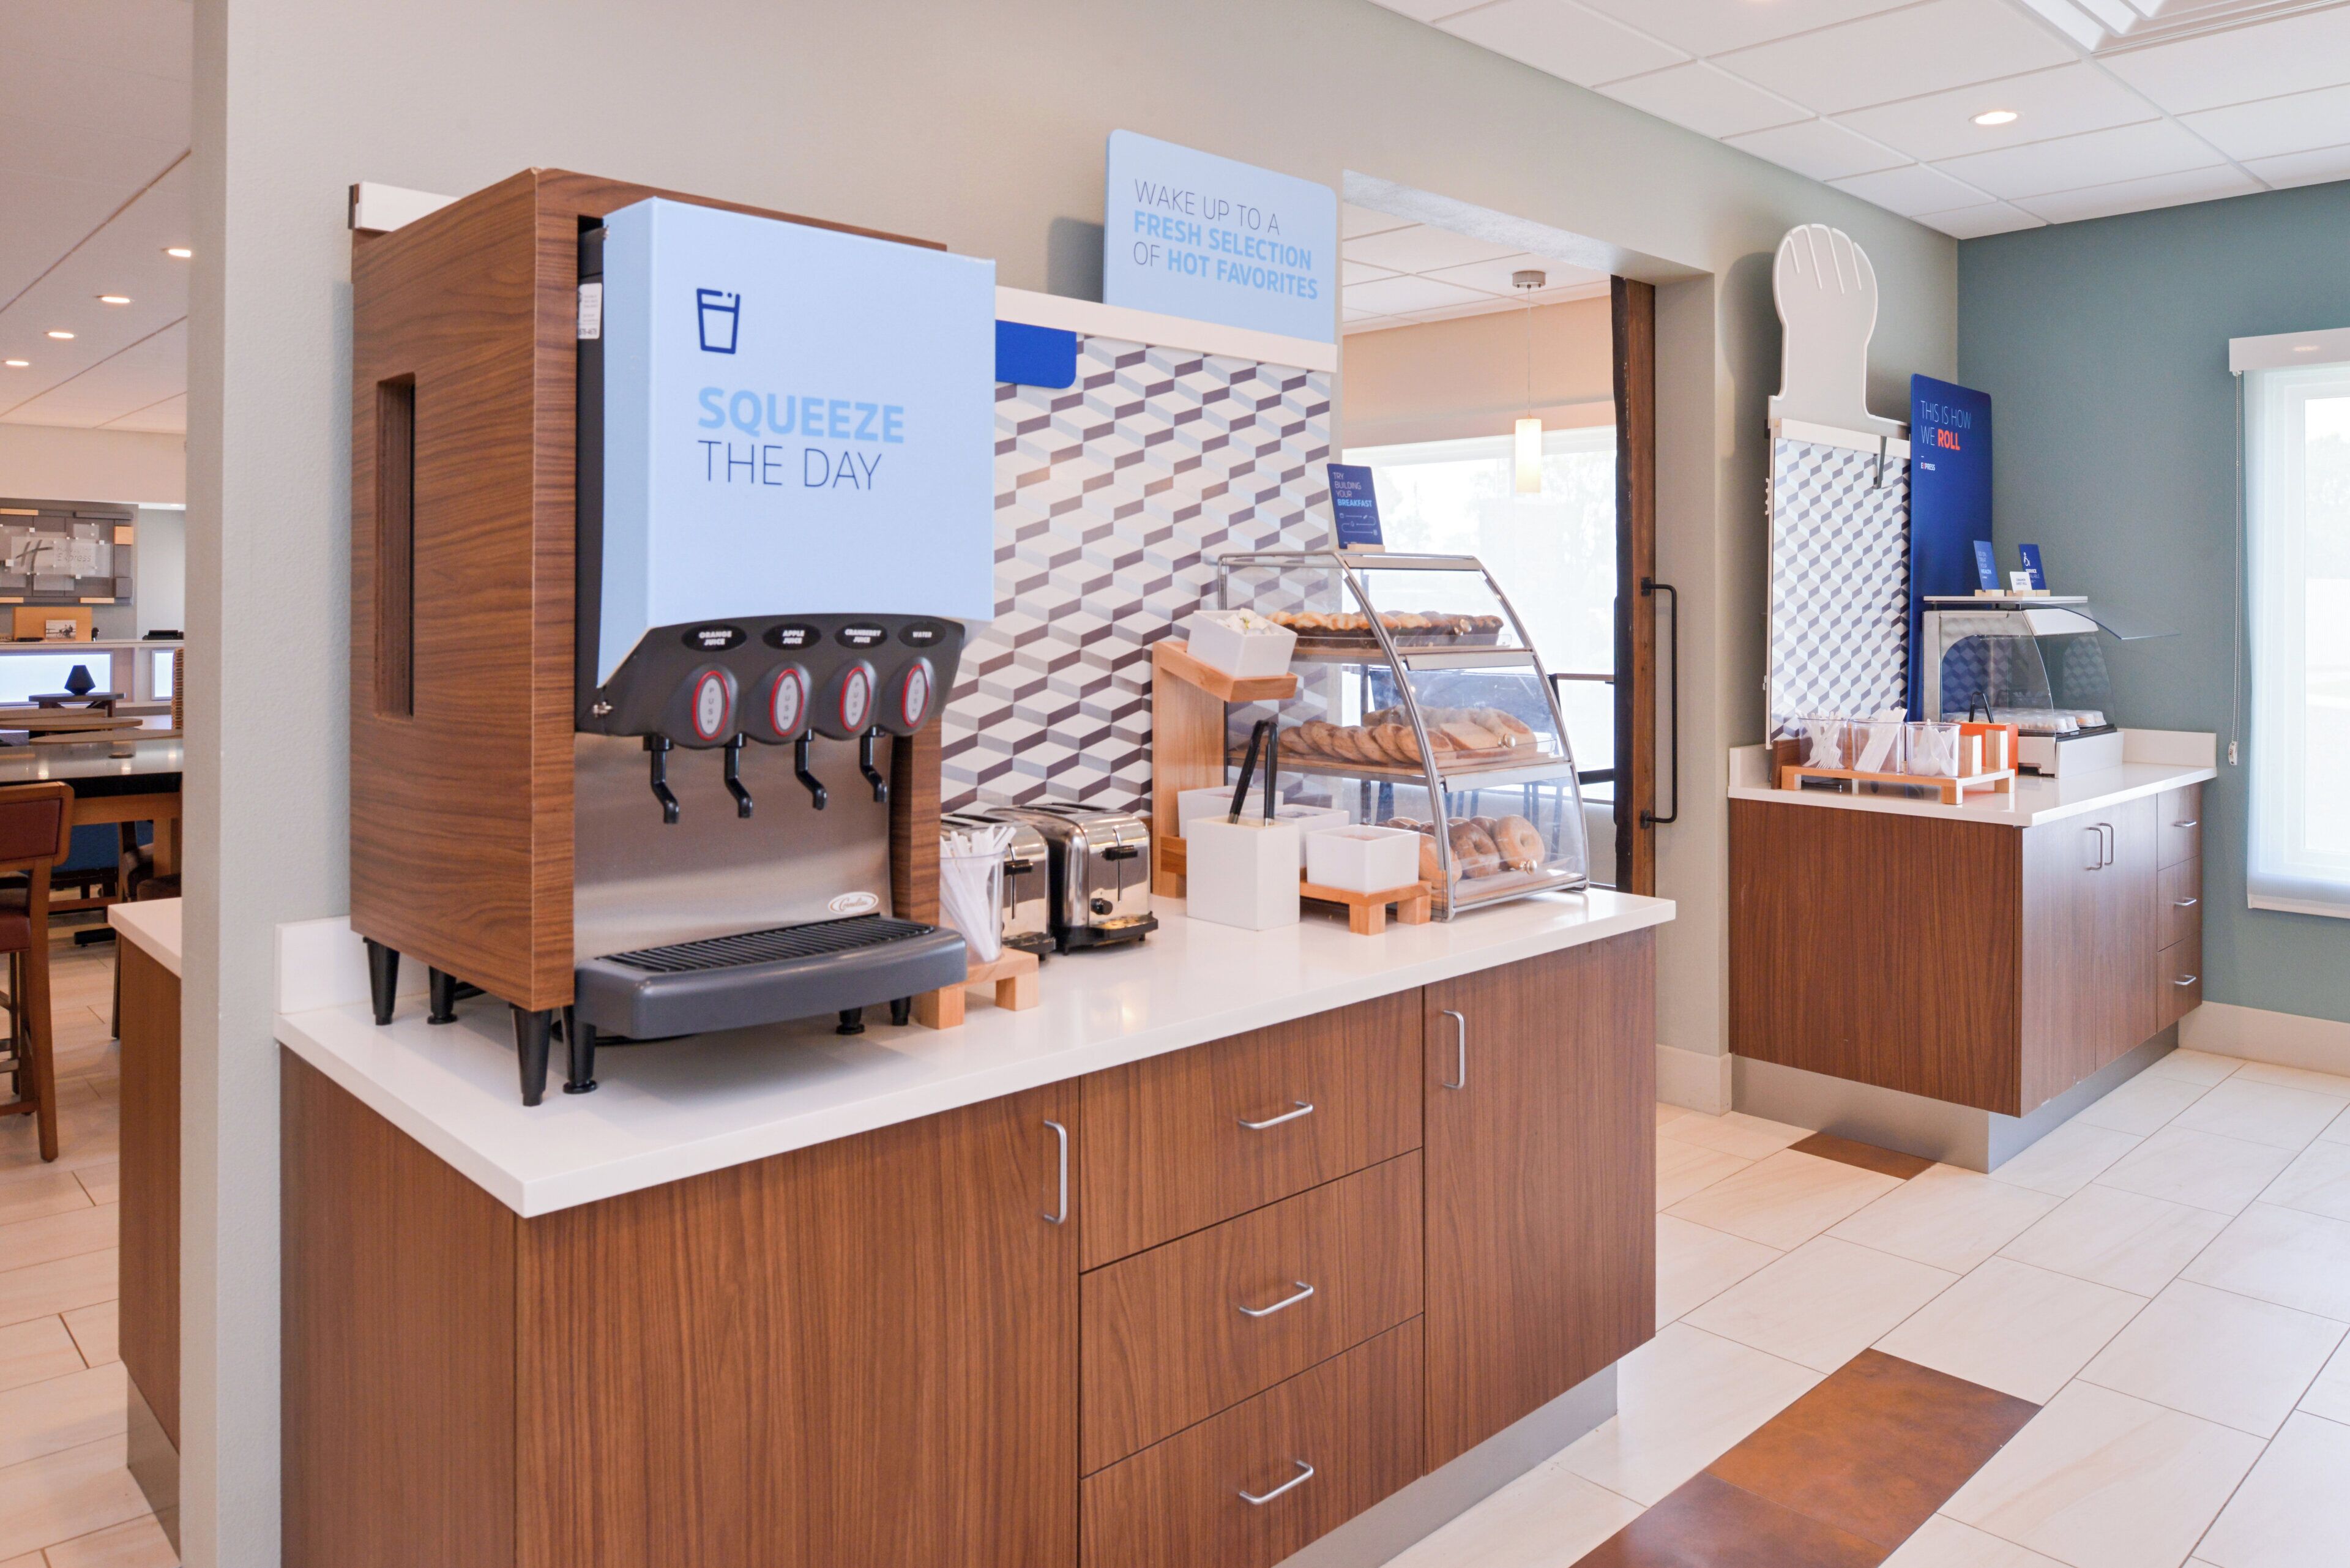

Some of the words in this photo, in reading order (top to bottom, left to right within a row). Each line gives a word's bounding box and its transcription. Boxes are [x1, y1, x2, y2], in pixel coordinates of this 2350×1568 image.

[1135, 178, 1195, 215] WAKE
[1203, 195, 1229, 222] UP
[1237, 204, 1261, 230] TO
[1267, 212, 1280, 236] A
[1134, 209, 1201, 246] FRESH
[1208, 228, 1312, 271] SELECTION
[1133, 241, 1160, 267] OF
[1167, 248, 1210, 277] HOT
[1217, 259, 1318, 300] FAVORITES
[698, 386, 905, 444] SQUEEZE
[1921, 400, 1939, 422] THIS
[1941, 406, 1949, 425] IS
[1951, 408, 1971, 429] HOW
[1920, 425, 1935, 446] WE
[1938, 428, 1960, 450] ROLL
[698, 439, 783, 485] THE
[804, 447, 882, 491] DAY
[1921, 462, 1935, 471] EXPRESS
[1334, 481, 1362, 490] BUILDING
[1337, 499, 1372, 507] BREAKFAST
[845, 629, 882, 637] CRANBERRY
[783, 684, 792, 722] PUSH
